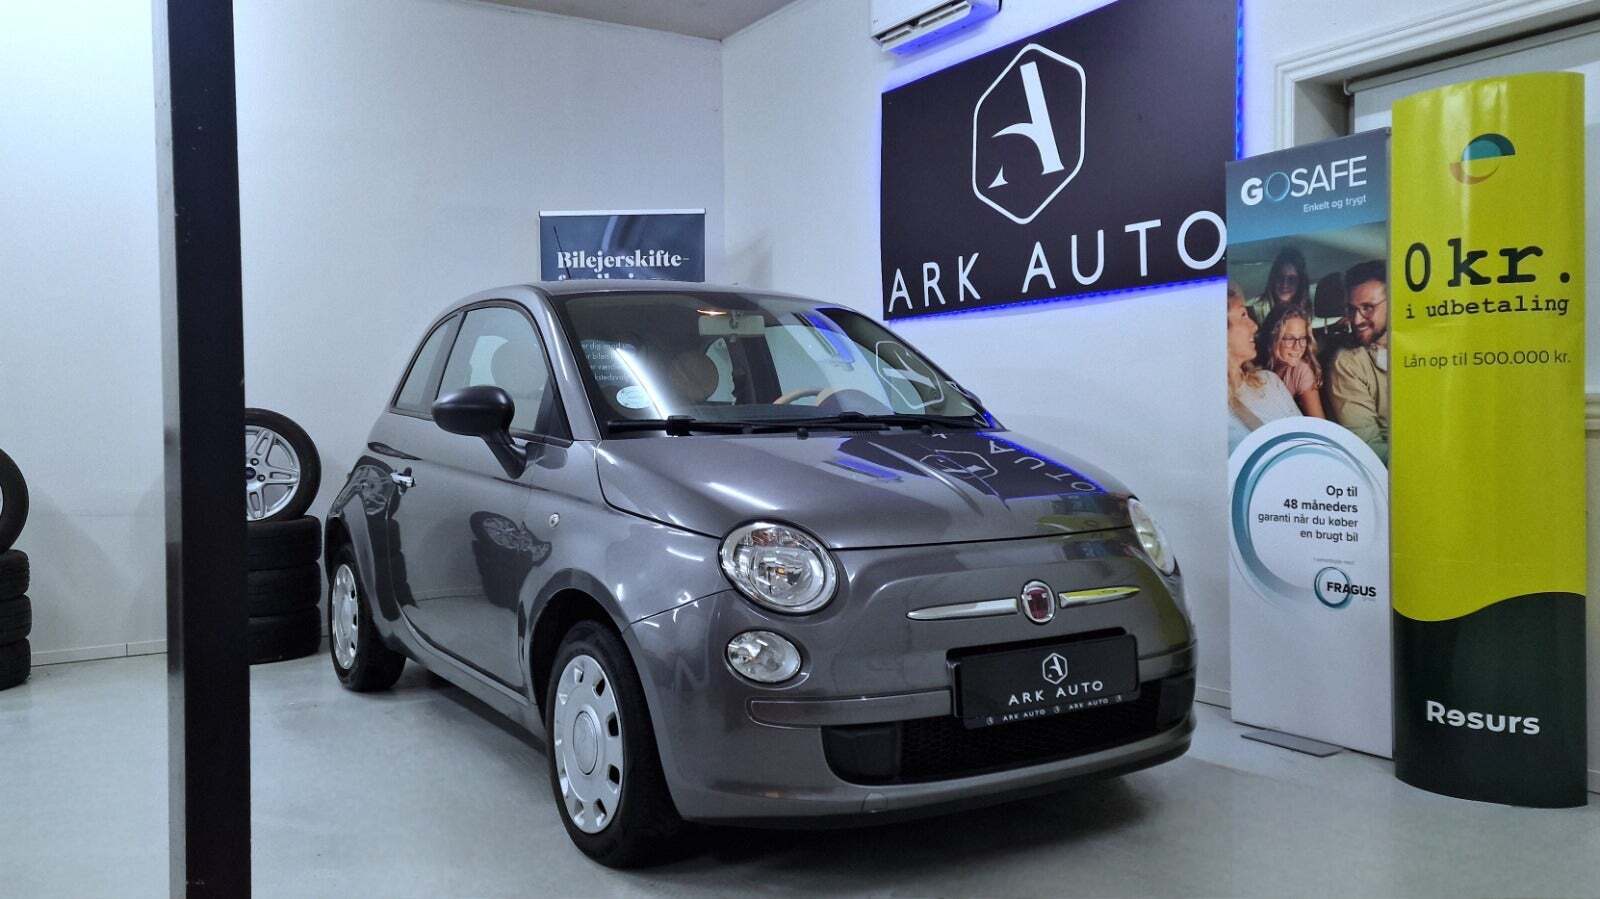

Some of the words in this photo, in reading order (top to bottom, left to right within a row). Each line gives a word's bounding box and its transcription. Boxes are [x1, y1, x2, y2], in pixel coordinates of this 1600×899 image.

[1240, 155, 1368, 206] GOSAFE
[1303, 199, 1330, 213] Enkelt
[1331, 199, 1343, 209] og
[1345, 195, 1367, 208] trygt
[888, 252, 981, 313] ARK
[1021, 210, 1228, 294] AUTO
[1404, 241, 1432, 293] 0
[1447, 236, 1571, 288] kr.
[1405, 303, 1416, 320] i
[1425, 294, 1570, 317] udbetaling
[1403, 354, 1426, 369] Lån
[1429, 355, 1448, 370] op
[1452, 352, 1468, 366] til
[1472, 350, 1550, 366] 500.000
[1554, 349, 1572, 364] kr.
[1325, 484, 1344, 498] Op
[1347, 486, 1358, 497] til
[1283, 499, 1298, 510] 48
[1301, 500, 1359, 513] måneders
[1257, 512, 1291, 524] garanti
[1293, 513, 1309, 525] når
[1312, 515, 1326, 526] du
[1328, 516, 1359, 528] køber
[1299, 530, 1313, 538] en
[1315, 529, 1343, 543] brugt
[1346, 531, 1359, 542] bil
[1326, 581, 1377, 598] FRAGUS
[1008, 690, 1045, 707] ARK
[1056, 680, 1104, 698] AUTO
[1002, 713, 1019, 722] ARK
[1023, 709, 1047, 719] AUTO
[1068, 702, 1084, 710] ARK
[1087, 698, 1109, 706] AUTO
[1426, 699, 1540, 735] Resurs
